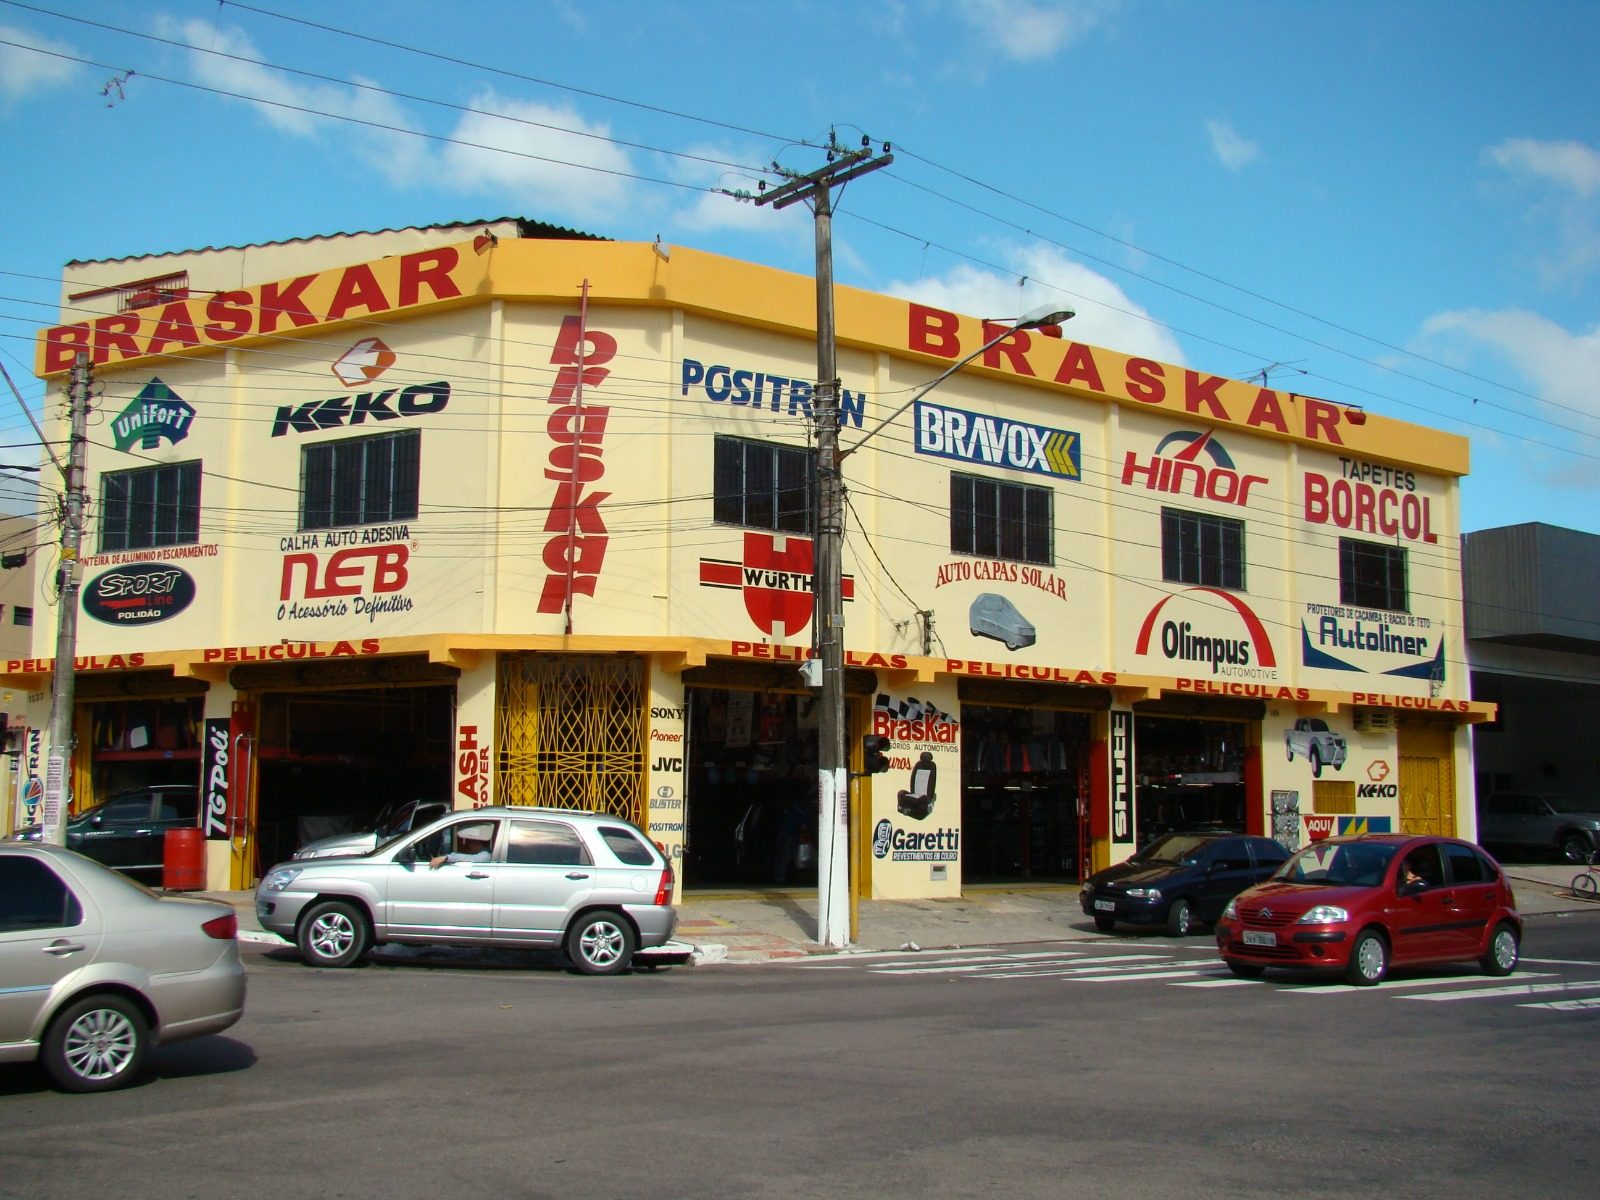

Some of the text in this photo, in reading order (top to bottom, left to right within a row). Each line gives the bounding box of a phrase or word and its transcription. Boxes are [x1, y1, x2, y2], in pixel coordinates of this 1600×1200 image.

[45, 247, 462, 373] BRASKAR
[908, 302, 1343, 444] BRASKAR
[682, 358, 865, 428] POSITRN
[272, 381, 451, 437] KEKO
[920, 405, 1051, 473] BRAVOX
[1339, 457, 1415, 491] TAPETES
[1304, 472, 1437, 544] BORCOL
[280, 525, 409, 551] CALHA AUTO ADESIVA
[80, 556, 109, 567] ONTEIRA
[111, 556, 121, 565] DE
[744, 568, 814, 592] WÜRTH
[935, 560, 1068, 601] AUTO CAPAS SOLAR
[118, 609, 161, 620] POLIDÃO
[289, 600, 348, 620] Acessório
[353, 595, 413, 623] Definitivo
[1307, 603, 1345, 618] PROTETORES
[1346, 609, 1353, 619] DE
[1384, 613, 1388, 623] E
[1408, 616, 1415, 627] DE
[1162, 620, 1249, 674] Olimpus
[1320, 616, 1428, 656] Autoliner
[7, 652, 145, 673] PELIULAS
[1221, 667, 1277, 680] AUTOMOTIVE
[650, 707, 684, 719] SONY
[650, 729, 683, 742] Pioneer
[914, 744, 959, 753] AUTOMOTIVOS
[458, 725, 479, 808] ASH
[480, 745, 489, 808] OVER
[652, 757, 682, 772] JVC
[1357, 783, 1397, 797] KEKO
[1308, 819, 1331, 832] AQUI
[893, 828, 959, 850] Garetti
